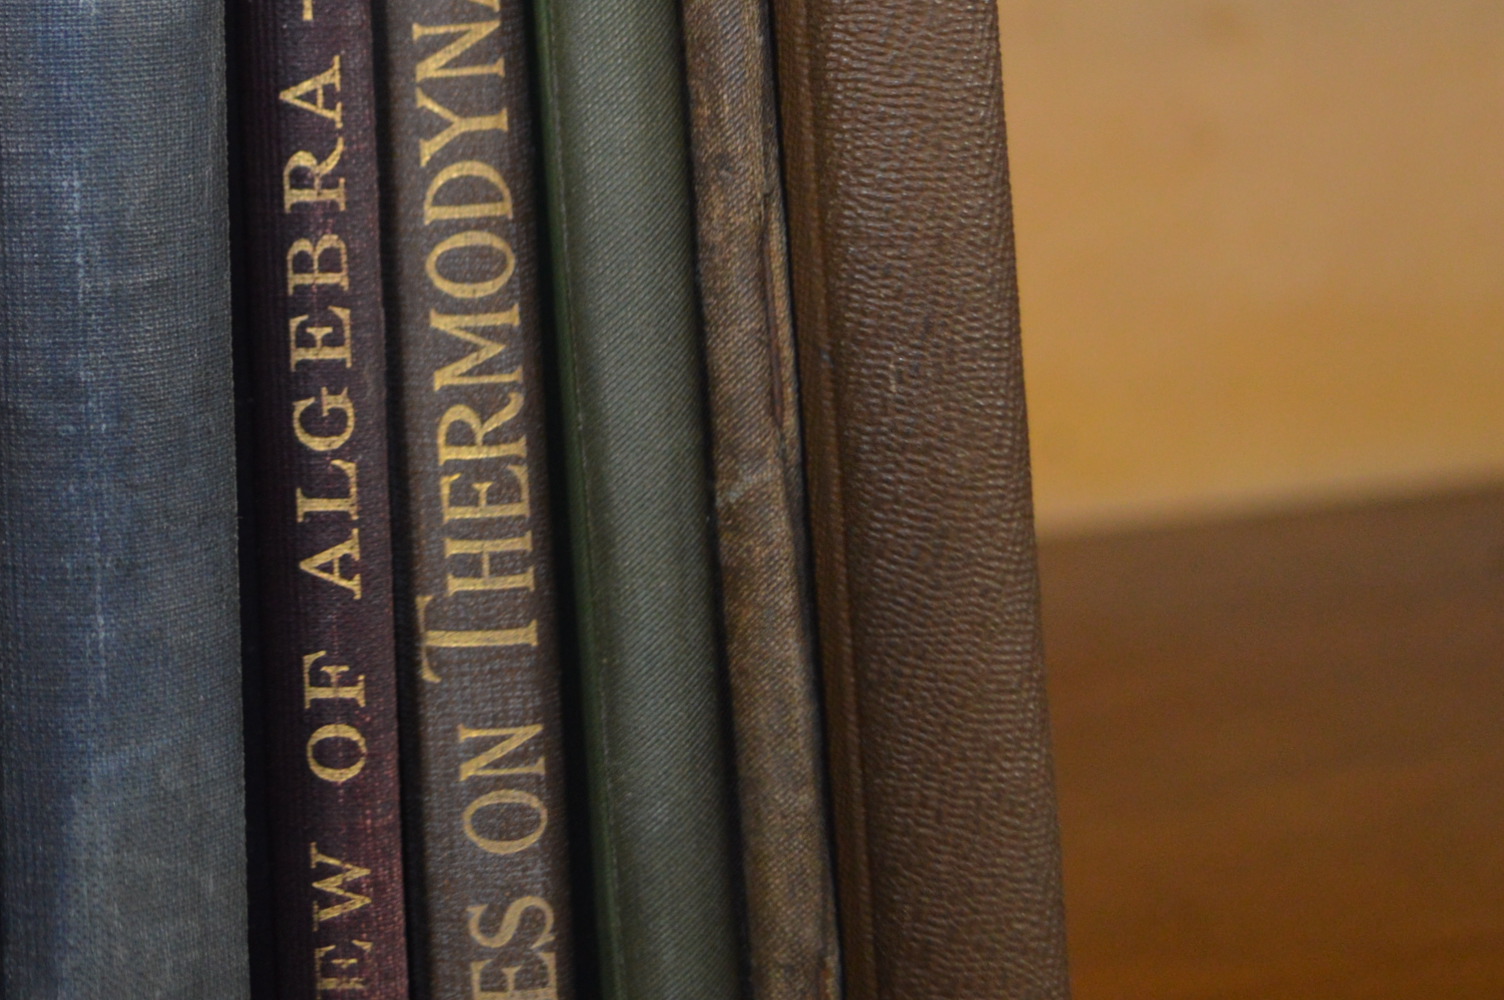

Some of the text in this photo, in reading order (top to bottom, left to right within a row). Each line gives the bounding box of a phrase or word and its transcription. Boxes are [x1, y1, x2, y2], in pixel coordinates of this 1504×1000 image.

[279, 55, 362, 600] ALGEBRA
[303, 650, 366, 783] OF
[458, 722, 547, 854] ON
